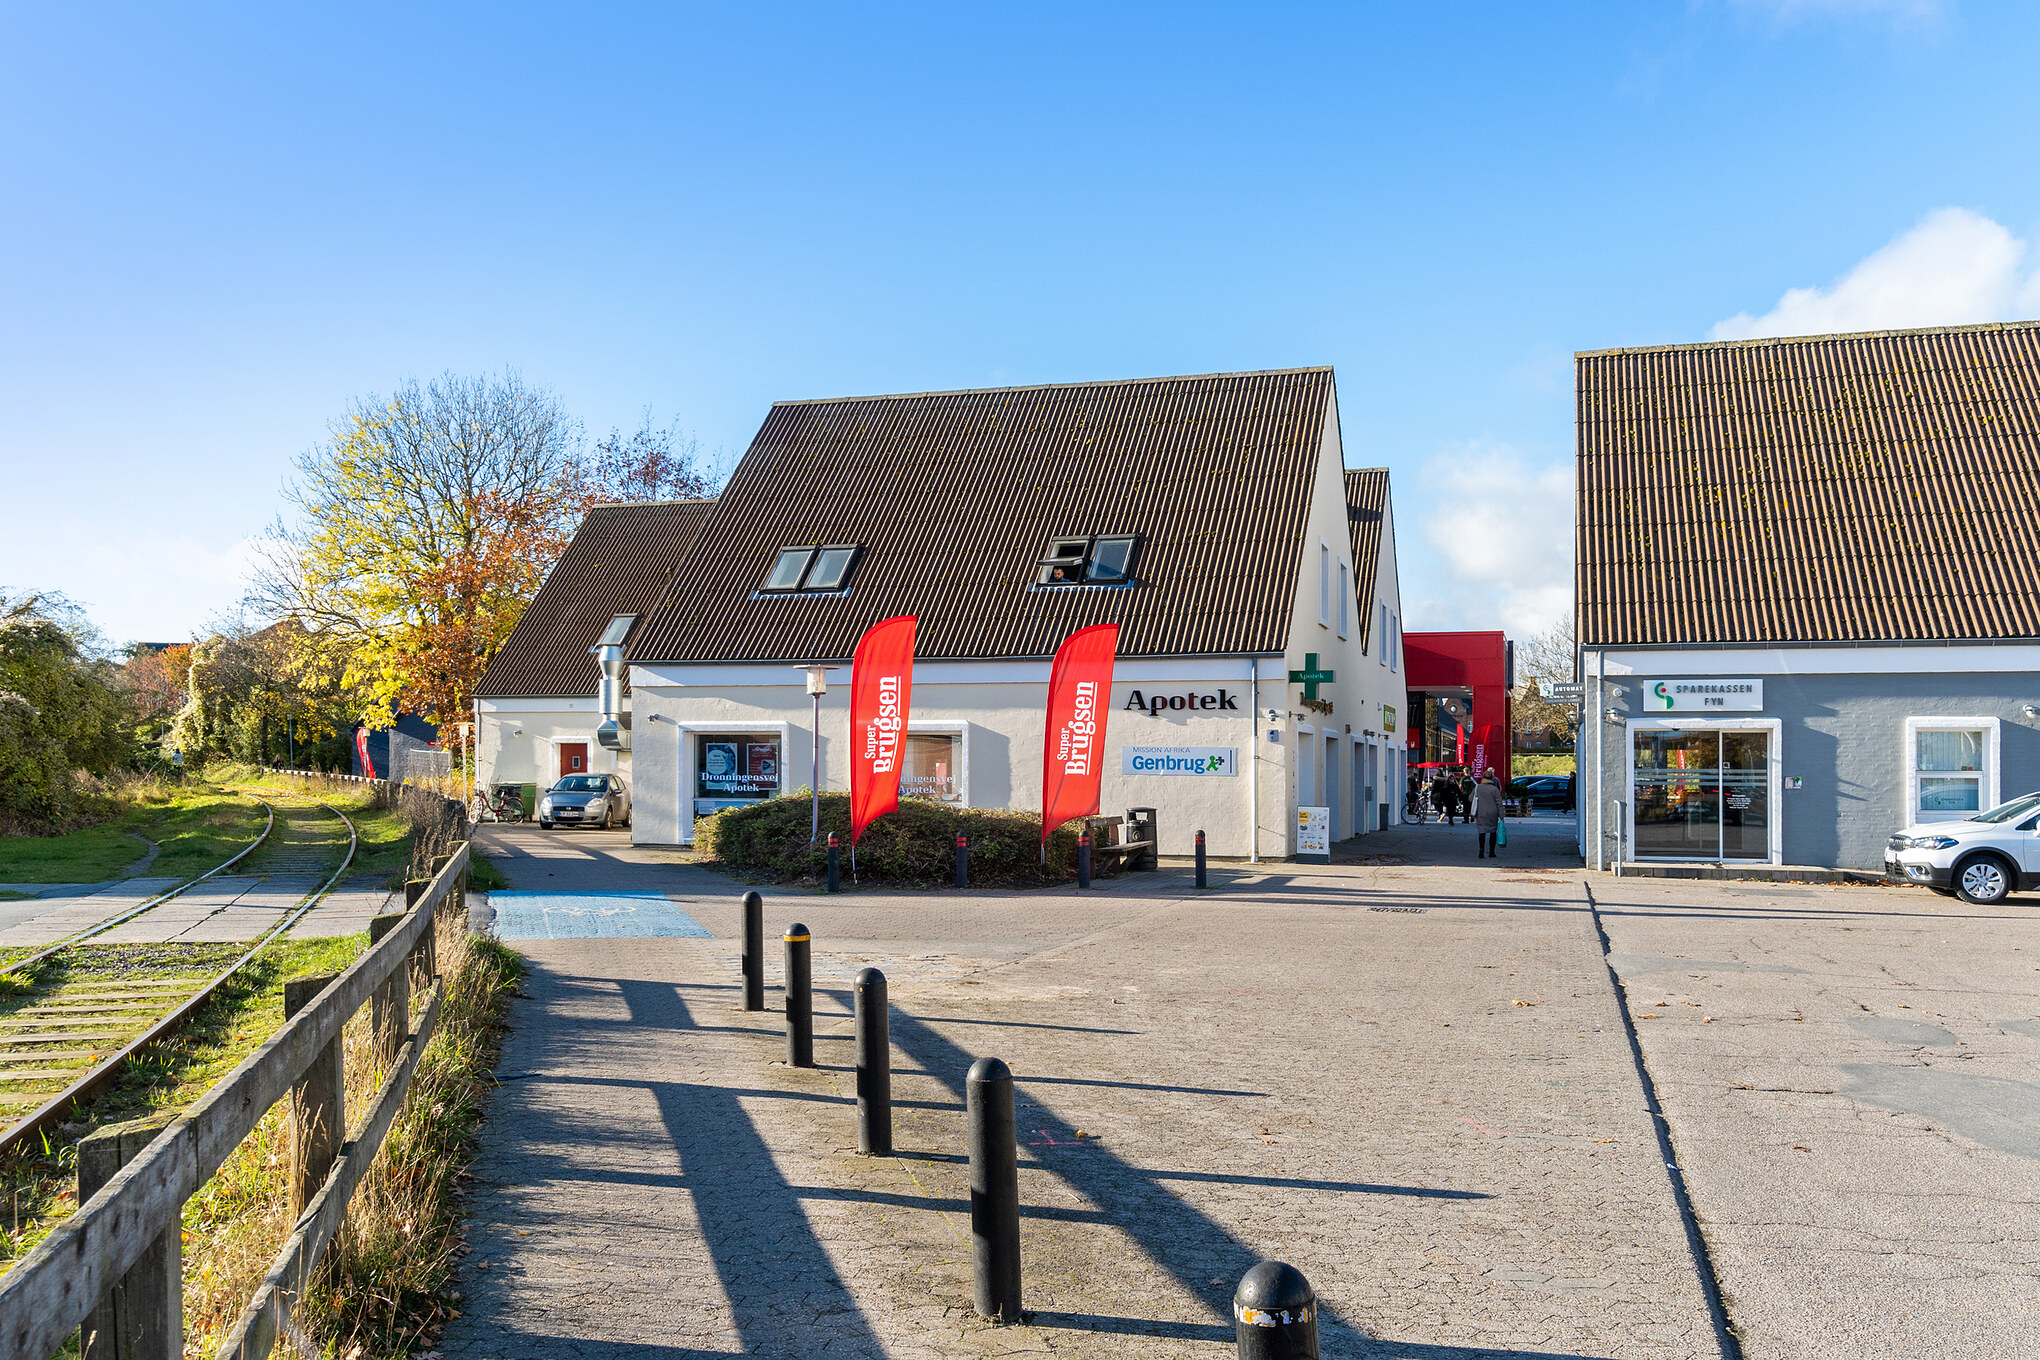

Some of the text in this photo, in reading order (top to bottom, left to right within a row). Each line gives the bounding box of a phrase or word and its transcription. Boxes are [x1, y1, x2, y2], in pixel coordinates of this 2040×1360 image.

[1297, 672, 1325, 680] Apotek
[1676, 684, 1753, 694] SPAREKASSEN
[1123, 689, 1238, 717] Apotek
[1704, 697, 1724, 706] FYN
[873, 675, 901, 774] Brugsen
[1065, 681, 1096, 776] Brugsen
[865, 725, 878, 759] Super
[1057, 728, 1072, 761] Super
[1132, 755, 1206, 774] Genbrug
[1474, 744, 1484, 778] Brugsen
[701, 772, 778, 783] Dronningensvej
[901, 774, 956, 784] ningensvej
[723, 783, 760, 793] Apotek
[898, 785, 936, 794] Apotek
